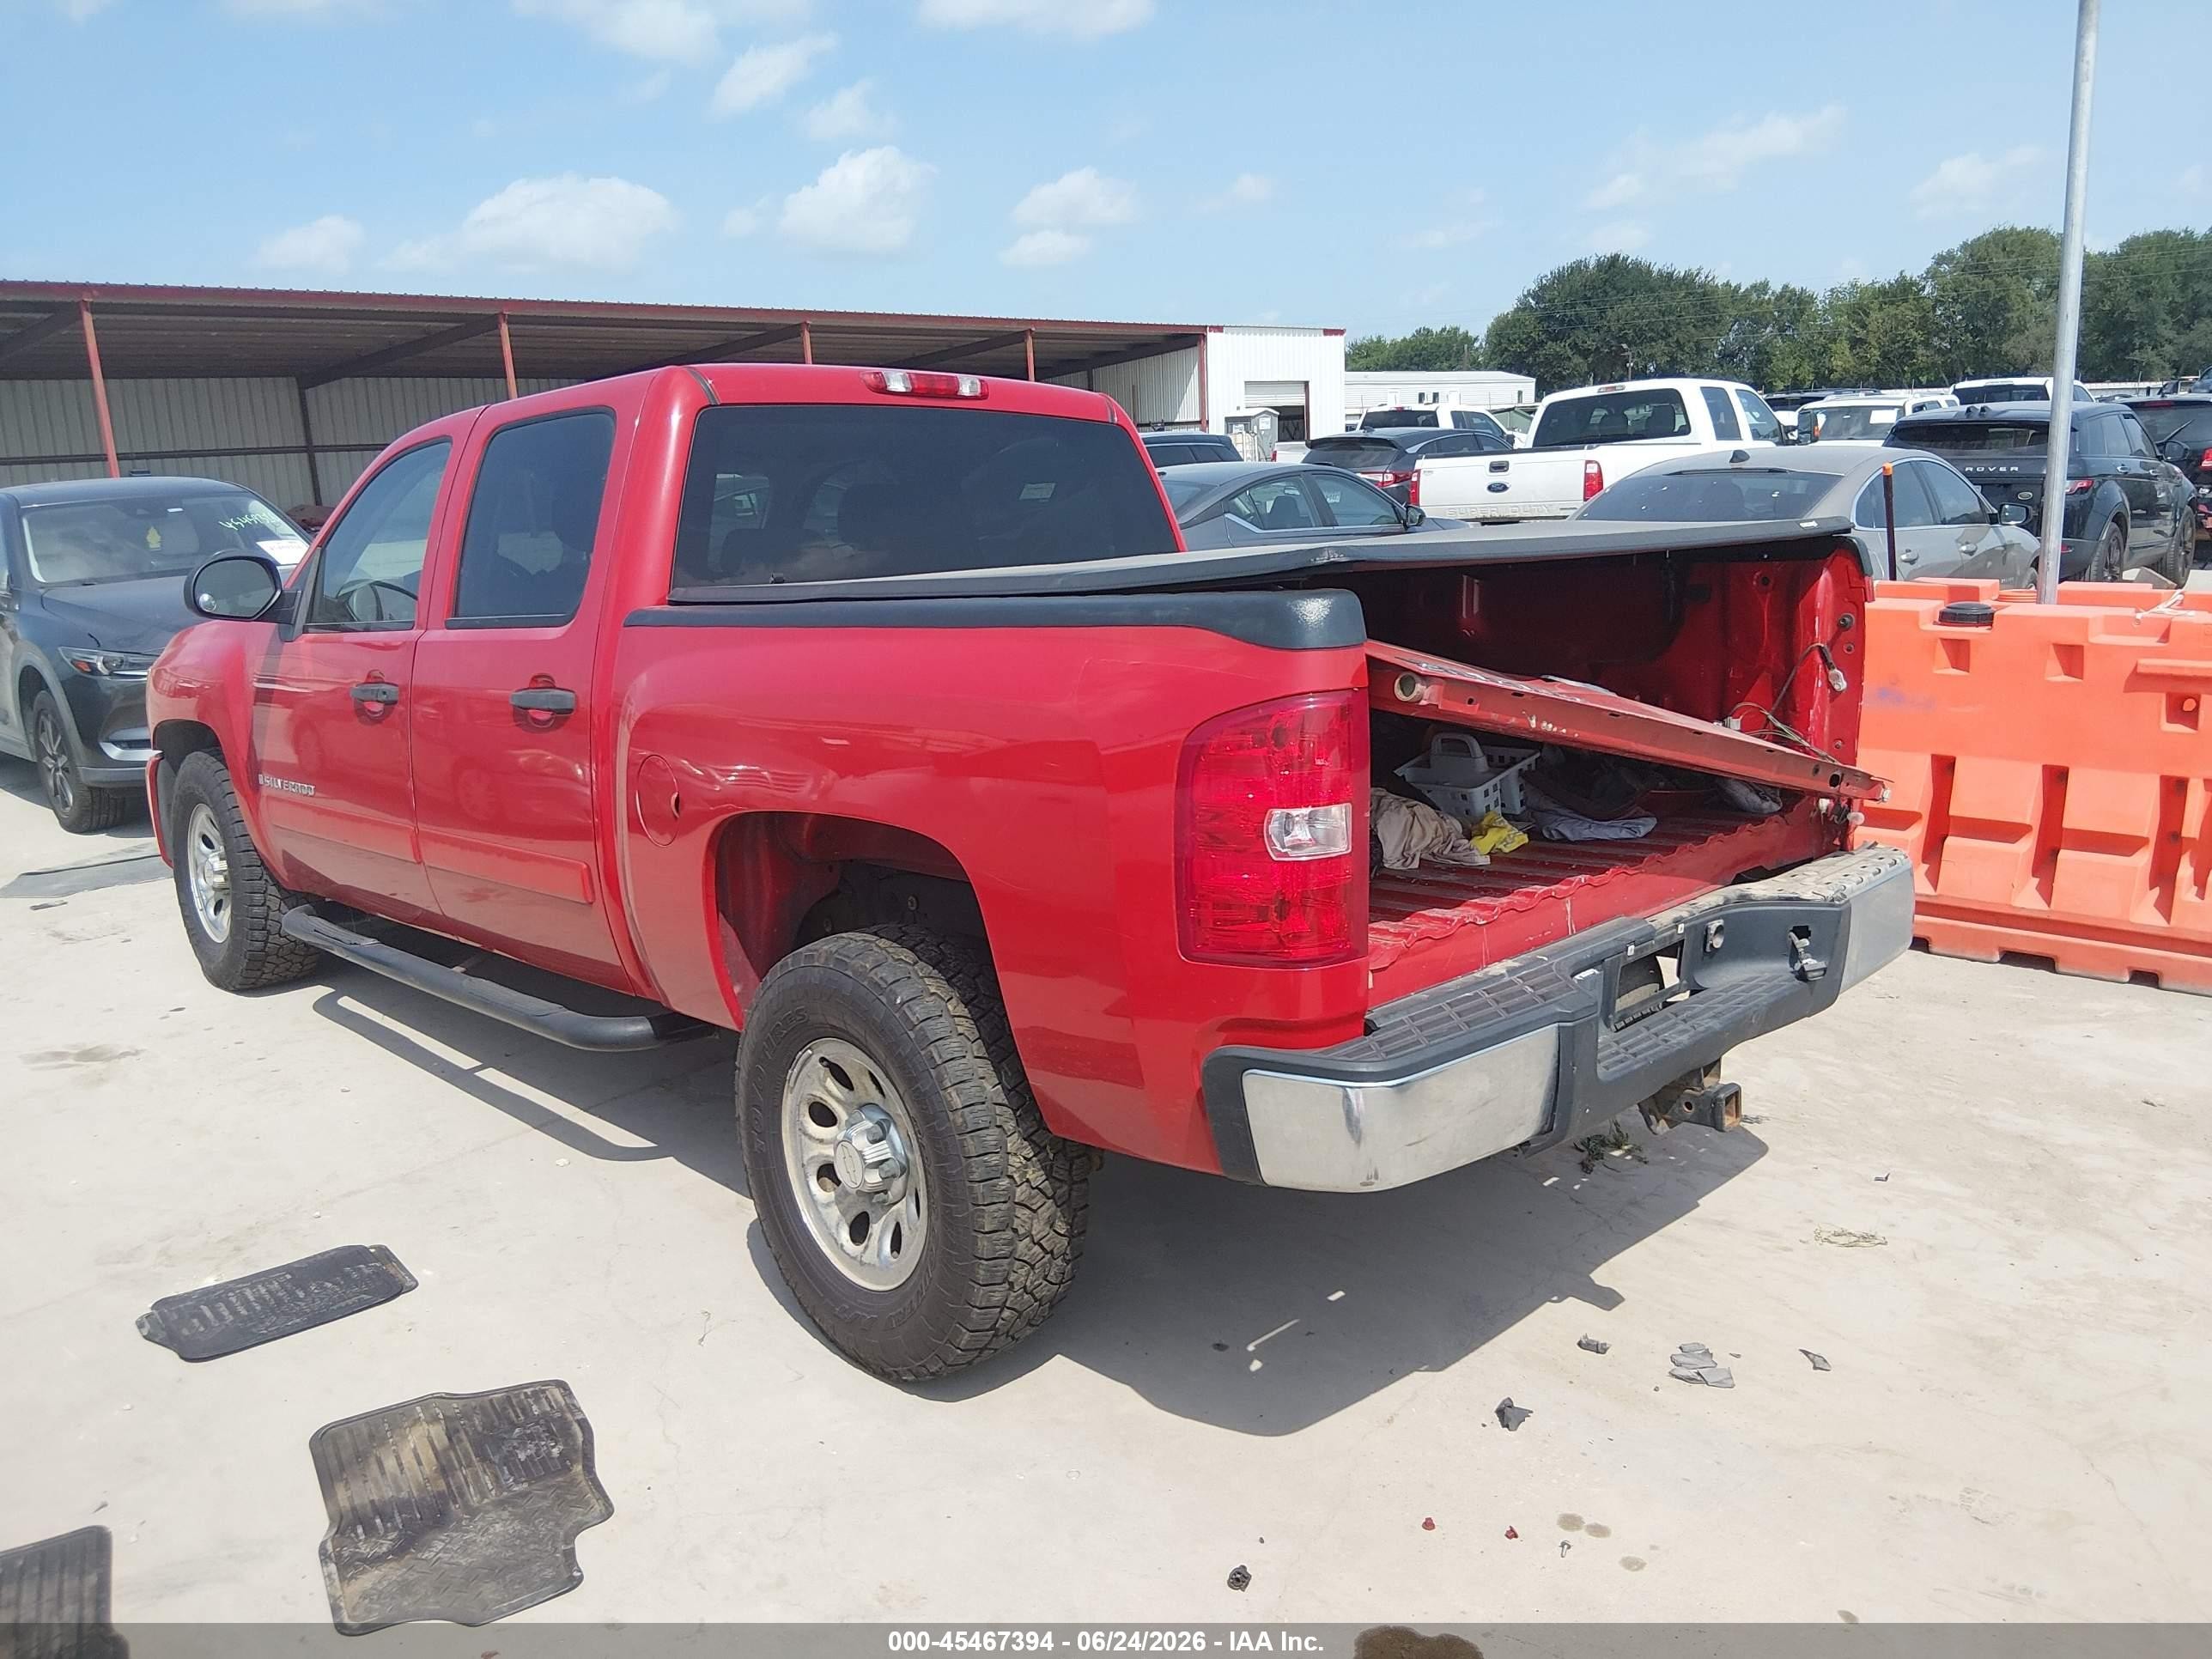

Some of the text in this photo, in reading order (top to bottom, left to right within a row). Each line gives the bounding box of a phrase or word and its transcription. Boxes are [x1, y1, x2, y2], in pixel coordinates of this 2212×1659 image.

[1447, 507, 1498, 516] SUPER
[1510, 505, 1552, 514] DUTY
[264, 775, 315, 796] SILVERADO
